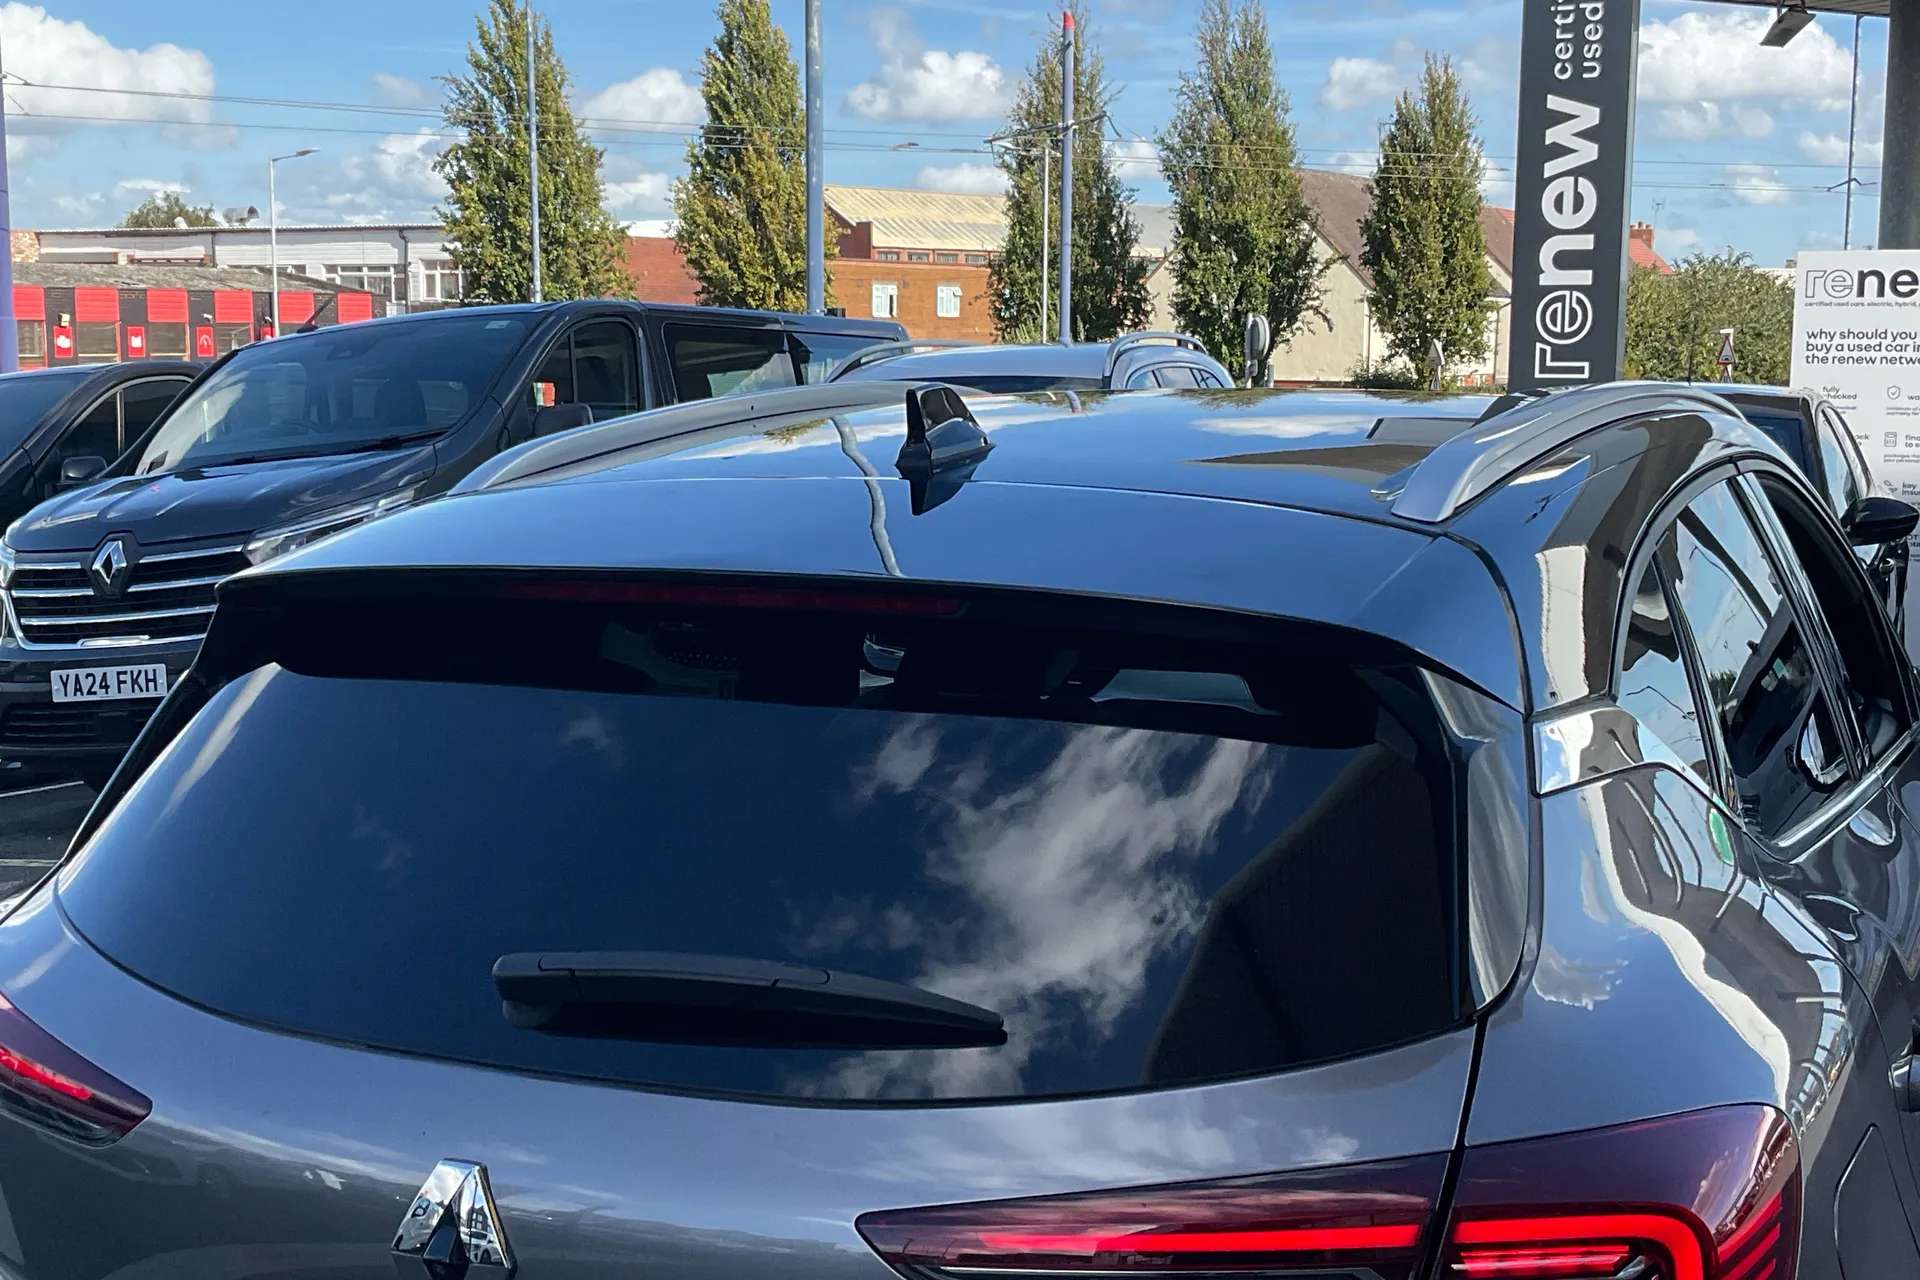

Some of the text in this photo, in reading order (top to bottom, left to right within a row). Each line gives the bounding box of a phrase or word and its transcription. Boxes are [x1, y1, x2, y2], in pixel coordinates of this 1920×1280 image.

[1551, 0, 1576, 79] certi
[1579, 2, 1604, 78] used
[1535, 94, 1601, 379] renew
[1806, 328, 1918, 343] why should you
[1806, 340, 1832, 354] buy
[1835, 343, 1844, 352] a
[1847, 340, 1882, 352] used
[1885, 343, 1911, 352] car
[1805, 353, 1920, 365] the renew netw
[59, 669, 158, 697] YA24 FKH
